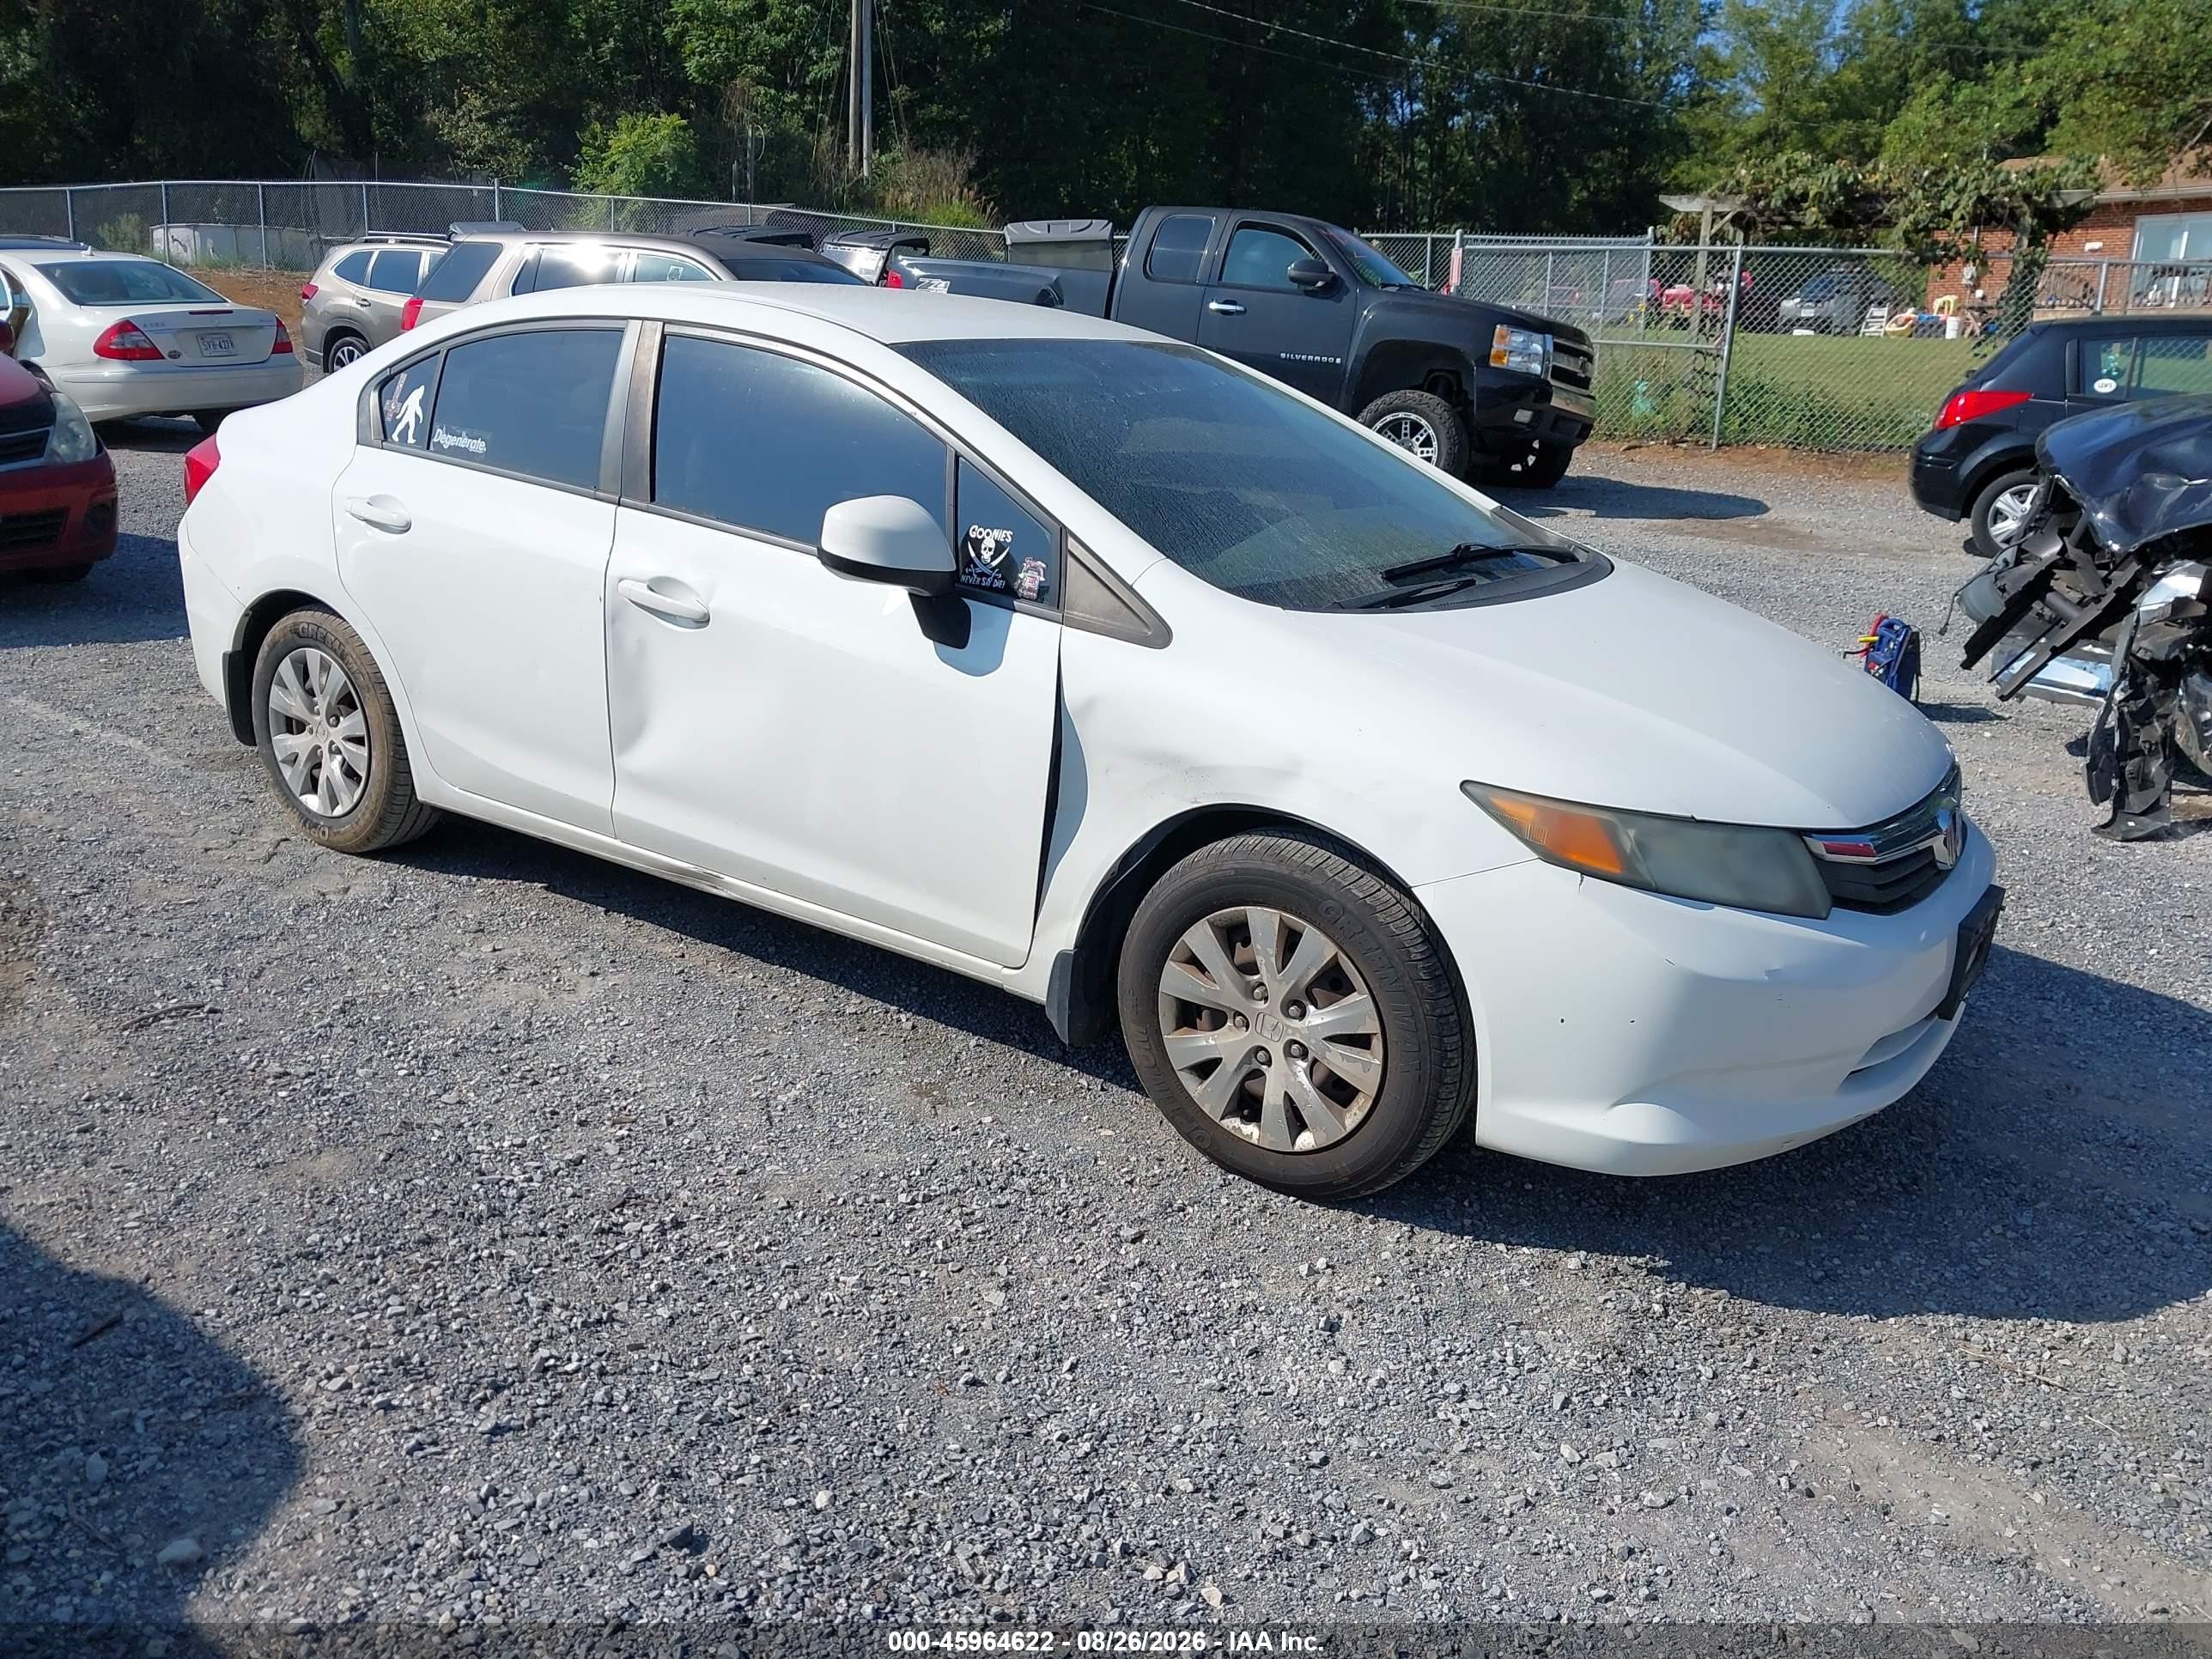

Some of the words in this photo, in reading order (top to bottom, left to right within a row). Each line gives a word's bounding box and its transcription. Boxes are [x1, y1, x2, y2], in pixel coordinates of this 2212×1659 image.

[1279, 352, 1334, 363] SILVERADO
[969, 525, 1013, 543] GOONIES
[960, 574, 981, 585] NEVER
